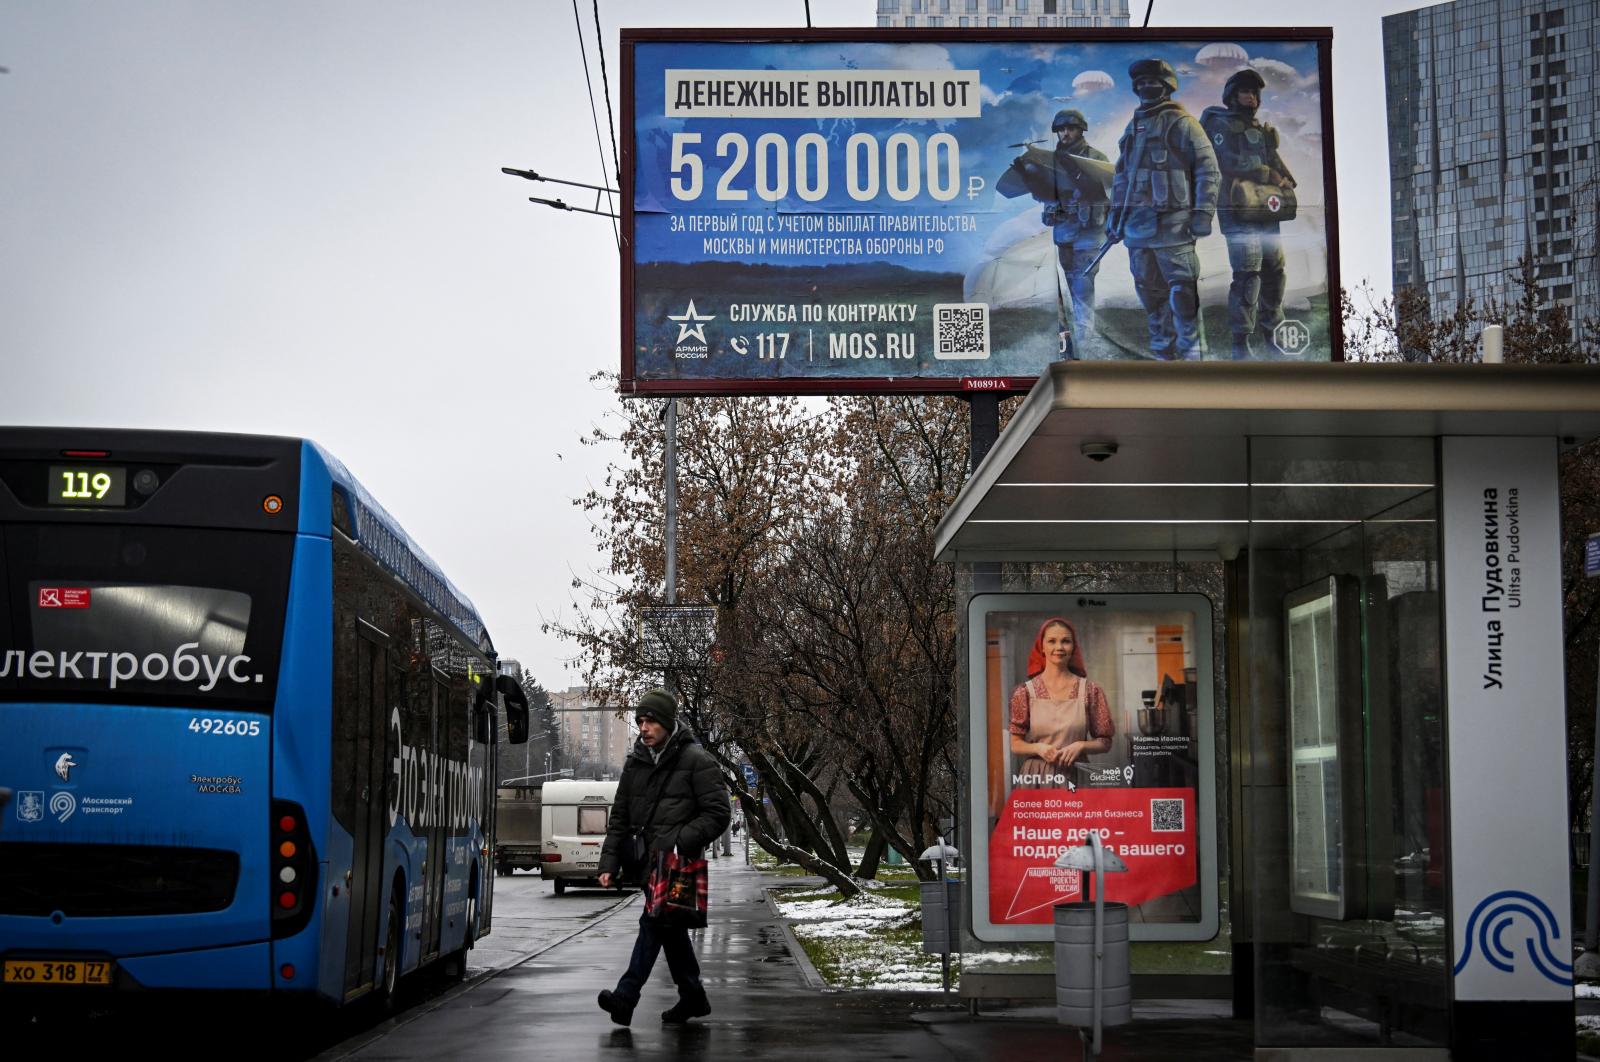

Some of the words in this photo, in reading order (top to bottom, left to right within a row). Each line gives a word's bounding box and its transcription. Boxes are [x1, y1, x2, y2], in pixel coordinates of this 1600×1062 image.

[675, 81, 809, 110] ДЕНЕЖНЫЕ
[817, 81, 935, 107] ВЫПЛАТЫ
[943, 81, 970, 107] ОТ
[670, 132, 703, 202] 5
[716, 132, 829, 202] 200
[846, 132, 960, 202] 000
[670, 216, 686, 232] ЗА
[689, 213, 738, 232] ПЕРВЫЙ
[742, 216, 764, 234] ГОД
[767, 216, 775, 232] С
[777, 216, 823, 232] УЧЕТОМ
[828, 216, 875, 232] ВЫПЛАТ
[879, 216, 977, 232] ПРАВИТЕЛЬСТВА
[703, 238, 755, 255] МОСКВЫ
[758, 238, 767, 255] И
[770, 238, 863, 255] МИНИСТЕРСТВА
[866, 238, 923, 255] ОБОРОНЫ
[927, 238, 944, 255] РФ
[730, 303, 797, 323] СЛУЖБА
[802, 303, 822, 323] ПО
[827, 303, 917, 323] КОНТРАКТУ
[1279, 325, 1308, 349] 18+
[756, 333, 790, 359] 117
[829, 333, 916, 359] MOS.RU
[967, 380, 1006, 390] M0891A
[62, 471, 112, 499] 119
[1506, 487, 1521, 563] Pudovkina
[1482, 487, 1505, 613] Пудовкина
[1508, 567, 1521, 609] Ulitsa
[1483, 619, 1504, 690] Улица
[188, 718, 260, 736] 492605
[191, 775, 242, 785] Электробус
[1012, 773, 1066, 785] МСП.РФ
[1089, 772, 1121, 781] бизнес
[198, 784, 241, 794] МОСКВА
[82, 797, 133, 805] Московский
[1013, 799, 1042, 808] Более
[1044, 799, 1062, 808] 800
[1065, 801, 1083, 809] мер
[82, 806, 124, 815] транспорт
[1013, 811, 1083, 820] господдержки
[1085, 811, 1102, 819] для
[1104, 809, 1144, 819] бизнеса
[1013, 826, 1063, 840] Наше
[1119, 844, 1185, 857] вашего
[1028, 868, 1078, 878] НАЦИОНАЛЬНЫЕ
[1055, 884, 1078, 892] РОССИИ
[42, 964, 77, 981] 318
[87, 963, 104, 977] 77
